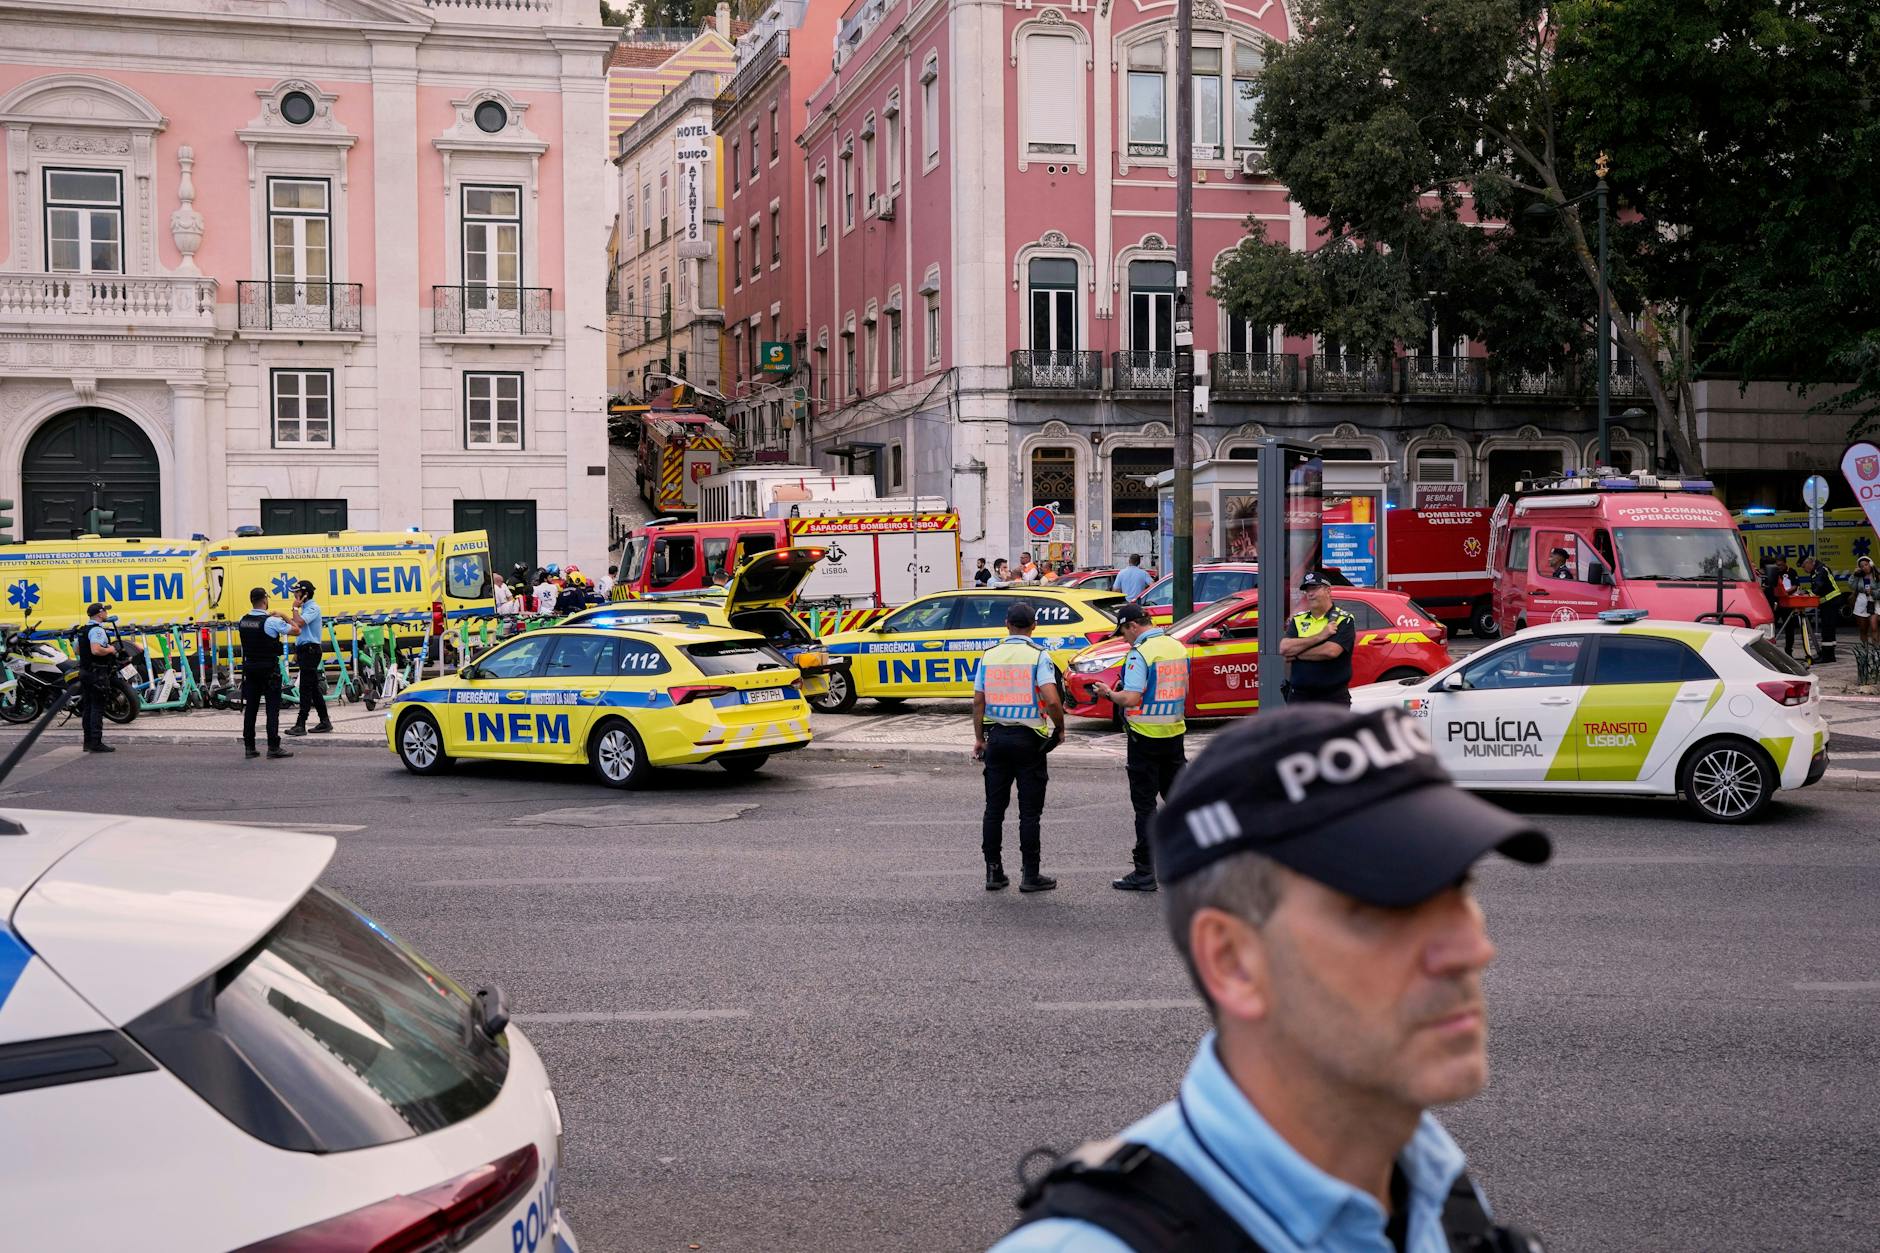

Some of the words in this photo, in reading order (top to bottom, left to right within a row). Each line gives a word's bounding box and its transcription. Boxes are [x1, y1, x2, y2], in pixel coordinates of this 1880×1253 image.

[677, 125, 708, 138] HOTEL
[1618, 508, 1660, 516] POSTO
[1663, 507, 1722, 516] COMANDO
[1631, 514, 1718, 522] OPERACIONAL
[1760, 544, 1815, 559] INEM
[82, 572, 184, 603] INEM
[330, 566, 422, 596] INEM
[1042, 607, 1070, 620] 112
[1402, 618, 1420, 627] 112
[170, 639, 191, 649] 12
[869, 641, 916, 653] EMERGÊNCIA
[948, 640, 974, 651] MINISTÉRIO
[630, 653, 660, 670] 112
[878, 658, 981, 684] INEM
[456, 690, 500, 704] EMERGÊNCIA
[750, 692, 760, 702] BF
[761, 692, 768, 701] 57
[770, 690, 780, 700] PH
[464, 712, 571, 744] INEM
[1448, 717, 1543, 742] POLÍCIA
[1584, 721, 1648, 734] TRÂNSITO
[1586, 734, 1637, 747] LISBOA
[1464, 744, 1544, 757] MUNICIPAL
